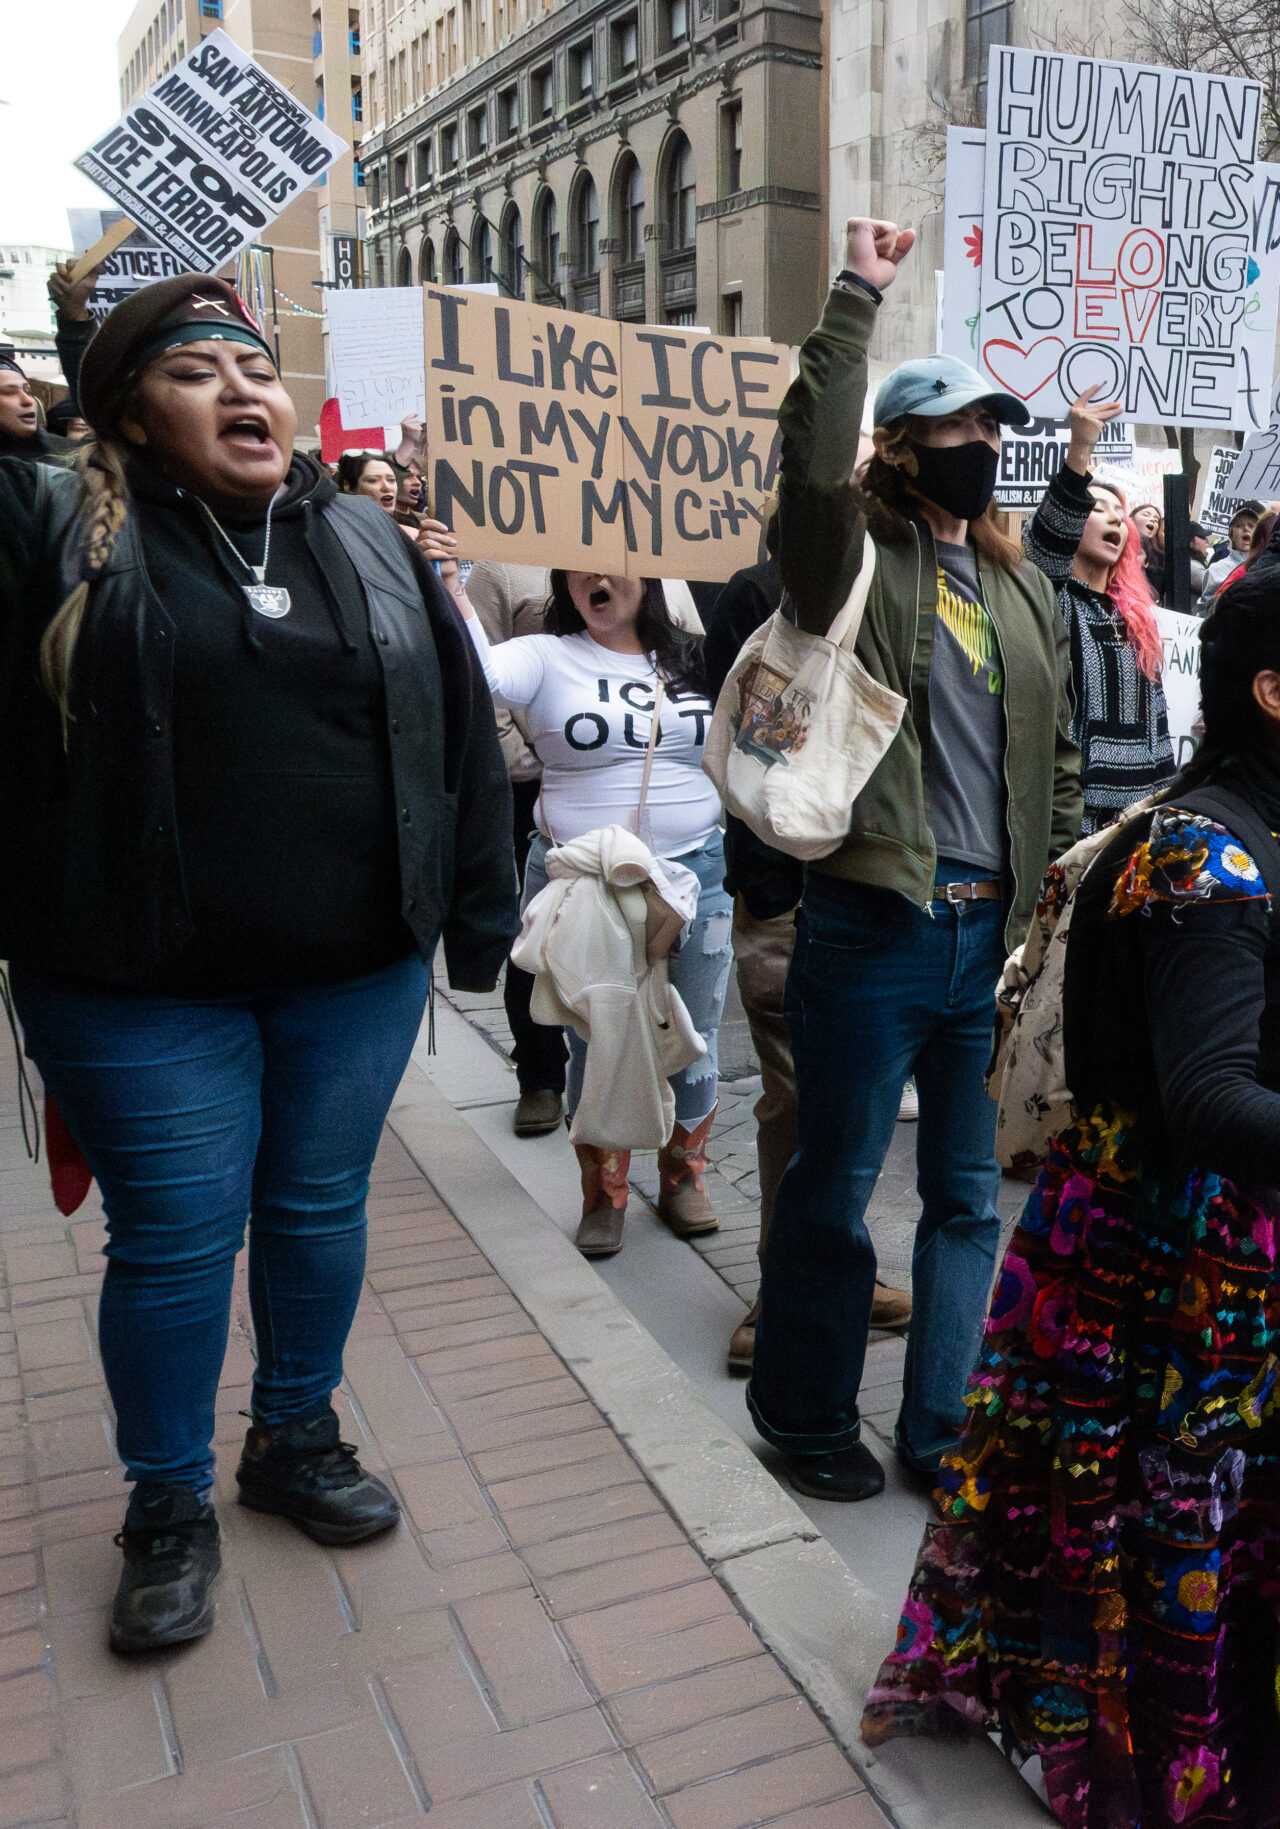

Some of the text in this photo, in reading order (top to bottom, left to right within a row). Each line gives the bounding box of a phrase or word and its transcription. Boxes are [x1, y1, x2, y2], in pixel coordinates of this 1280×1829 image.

[187, 44, 333, 176] SAN ANTONIO
[227, 109, 258, 141] TO
[245, 68, 306, 125] FROM
[998, 51, 1260, 164] HUMAN
[126, 107, 267, 229] STOP
[153, 73, 298, 203] MINNEAPOLIS
[92, 126, 244, 262] ICE TERROR
[998, 141, 1253, 229] RIGHTS
[103, 250, 161, 277] STICE
[154, 221, 170, 238] &
[995, 211, 1249, 292] BELONG
[428, 289, 474, 375] I
[494, 307, 617, 399] Like
[636, 332, 782, 420] ICE
[986, 285, 1245, 348] TO EVERY
[440, 385, 504, 448] in
[519, 400, 610, 480] MY
[1001, 440, 1069, 481] ERRO
[434, 459, 559, 535] NOT
[582, 478, 662, 556] MY
[1024, 490, 1033, 504] &
[564, 709, 713, 751] OUT
[597, 679, 713, 713] ICE
